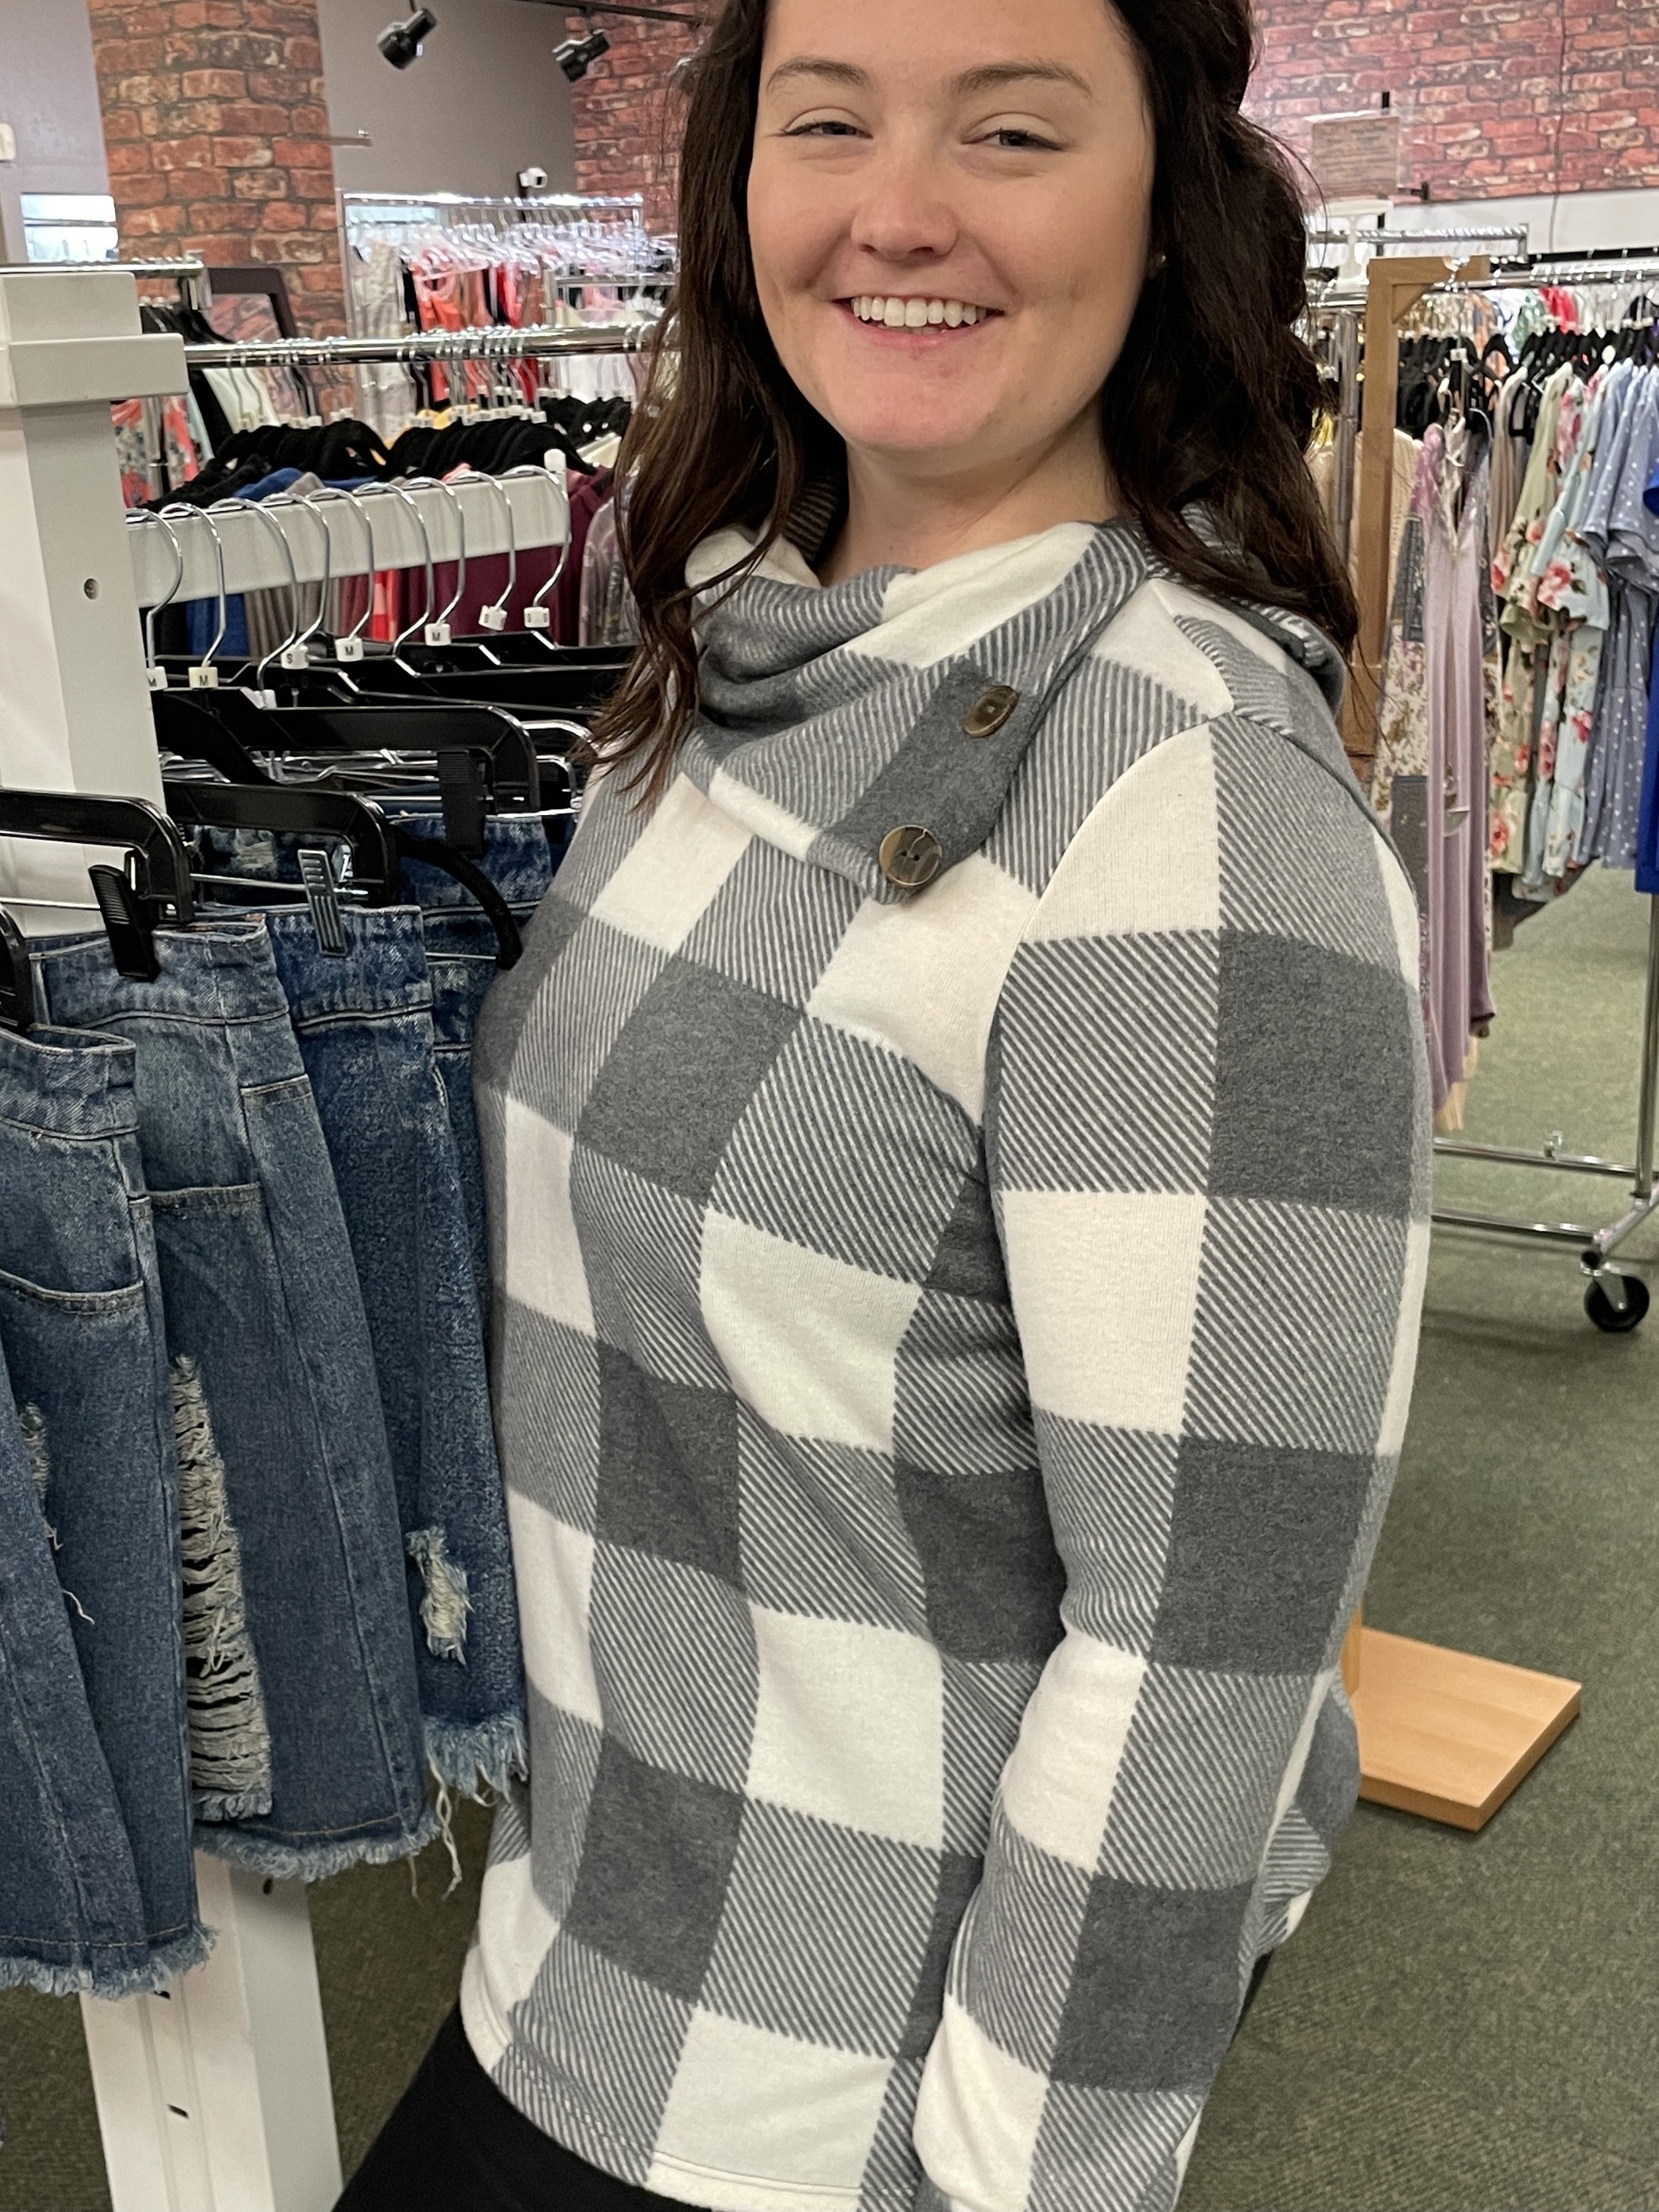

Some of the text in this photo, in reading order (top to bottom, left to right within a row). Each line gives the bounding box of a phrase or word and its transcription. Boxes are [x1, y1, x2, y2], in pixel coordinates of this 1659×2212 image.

[432, 632, 441, 642] M
[345, 646, 354, 656] M
[286, 653, 293, 665] S
[199, 675, 209, 687] M
